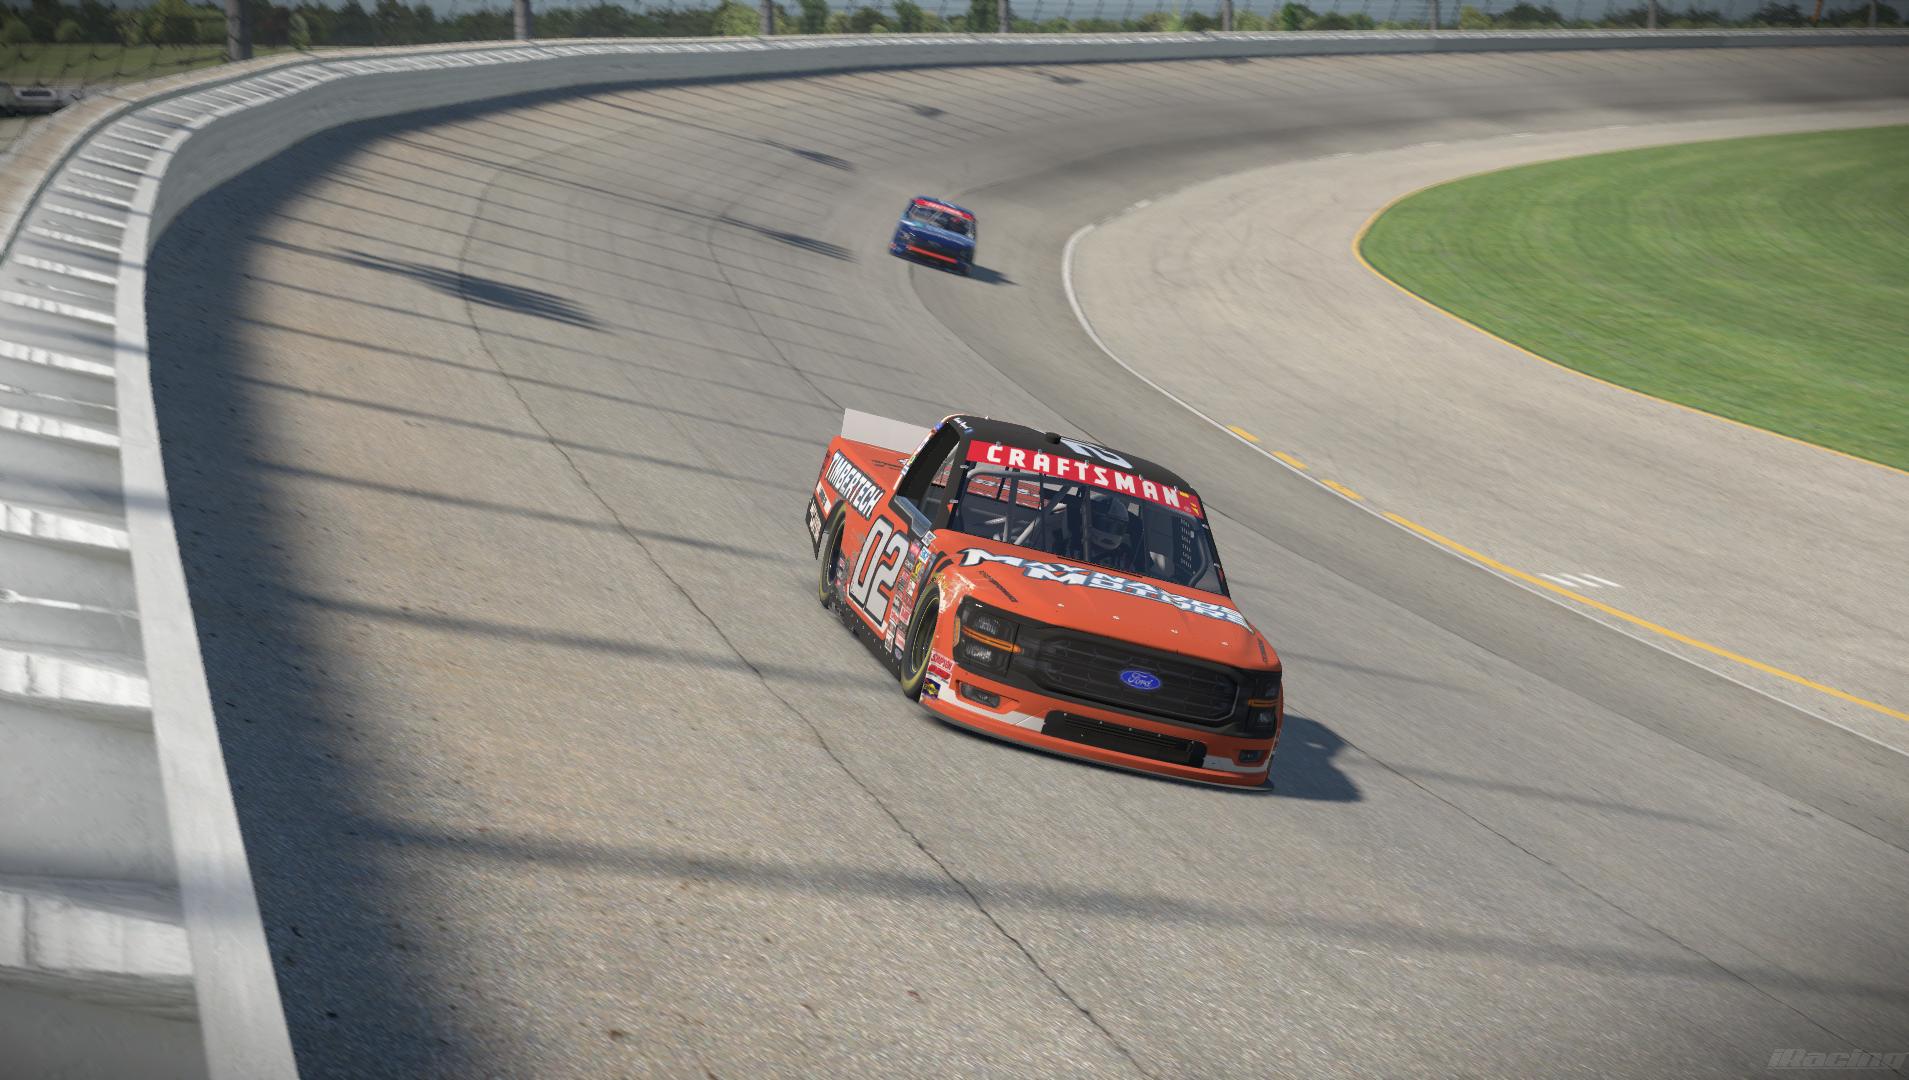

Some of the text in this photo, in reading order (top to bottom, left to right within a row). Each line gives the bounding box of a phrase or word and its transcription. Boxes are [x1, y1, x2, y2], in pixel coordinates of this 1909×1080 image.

[825, 450, 885, 519] TIMBERTECH
[986, 444, 1181, 508] CRAFTSMAN
[848, 516, 910, 626] 02
[1127, 668, 1153, 687] Ford
